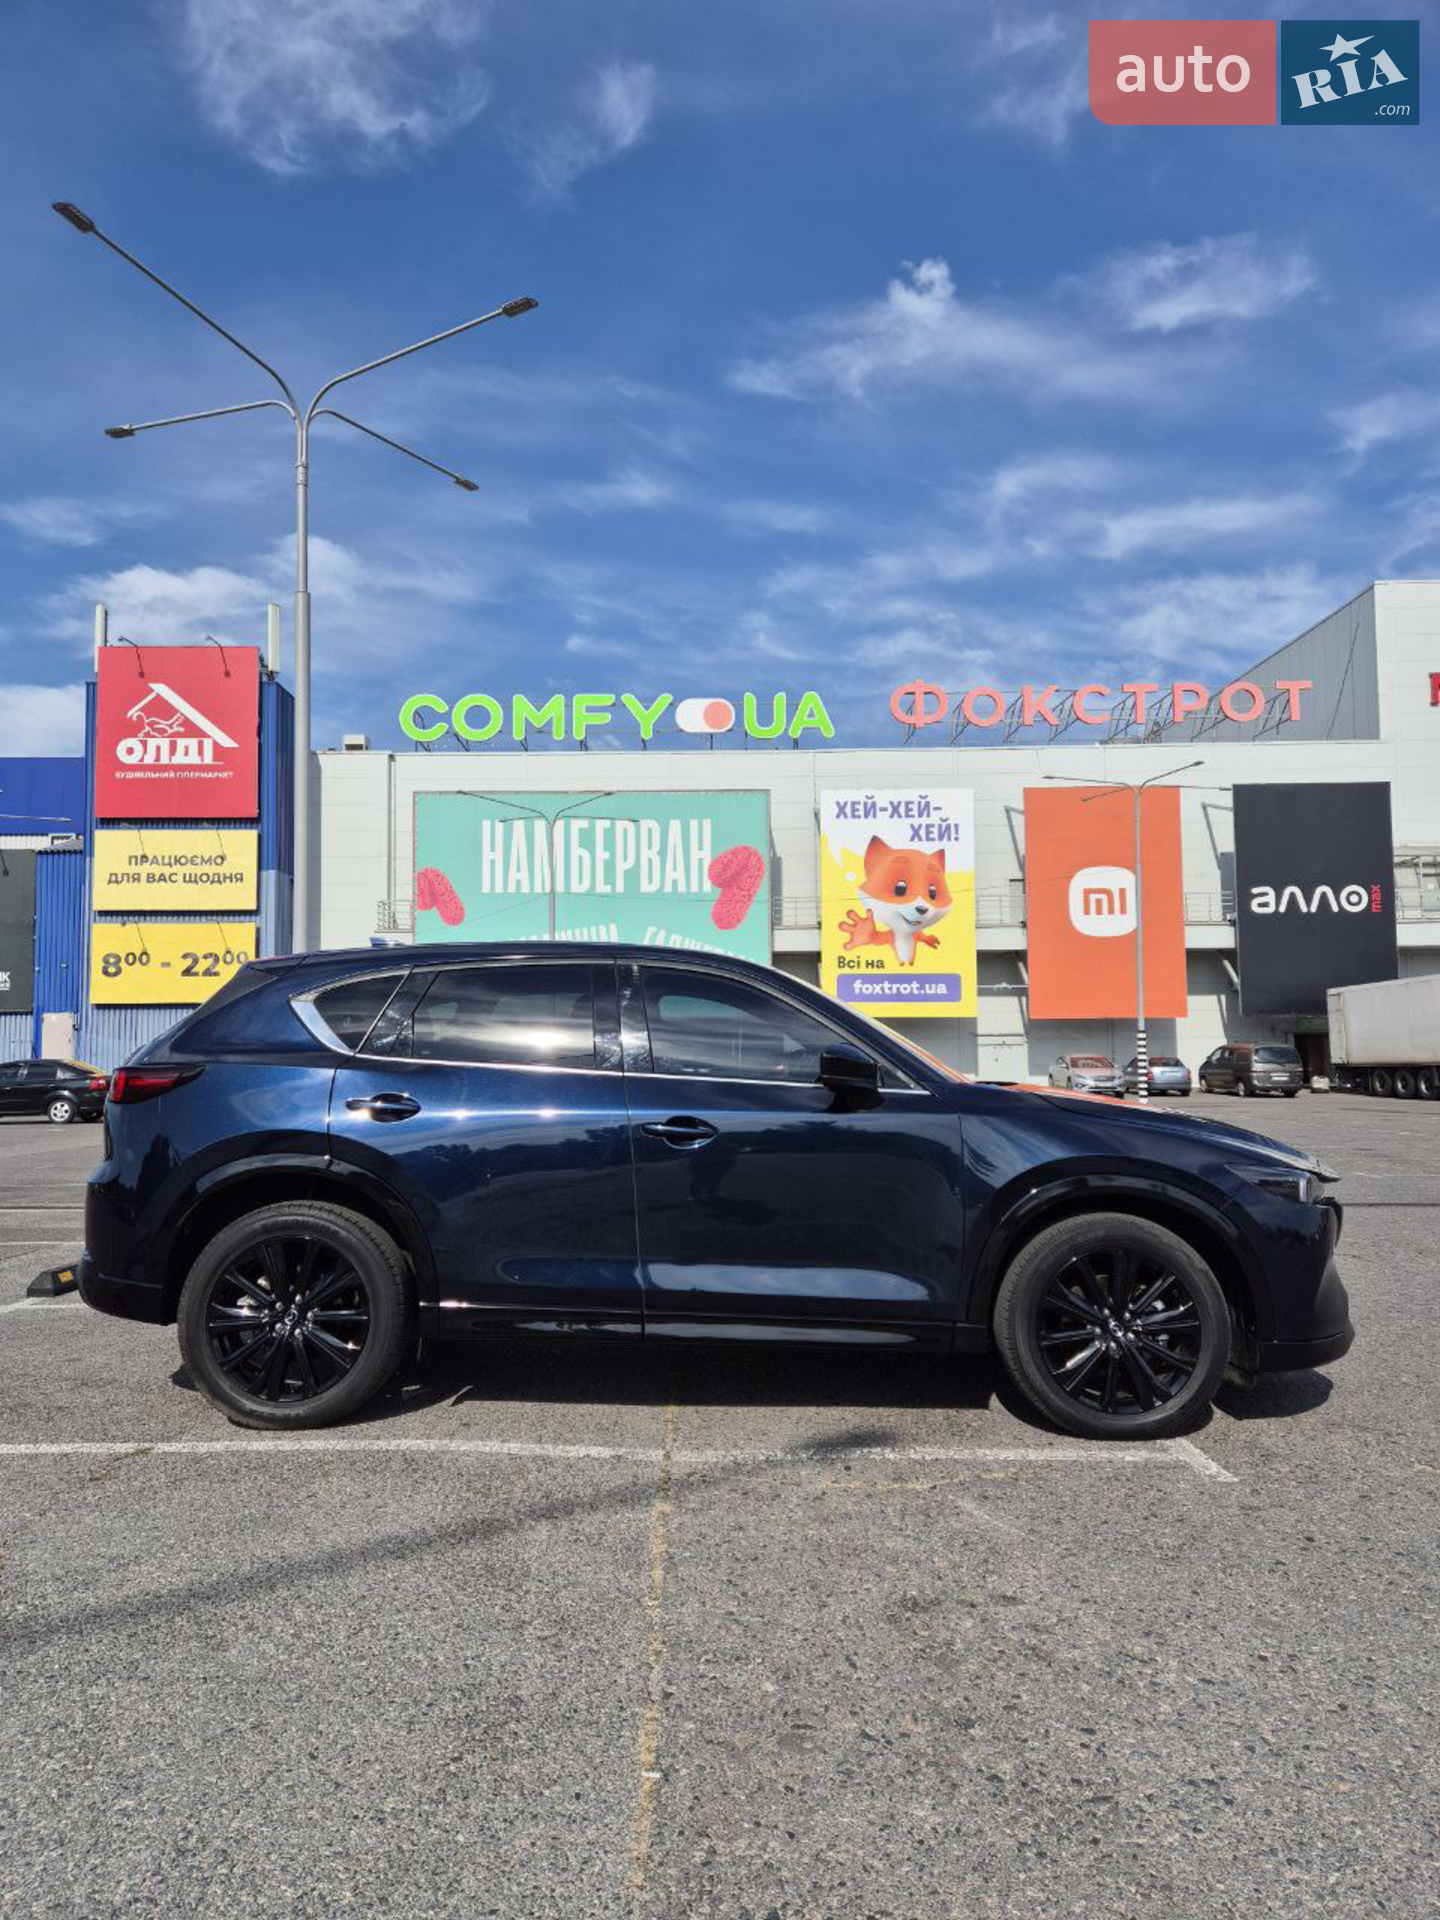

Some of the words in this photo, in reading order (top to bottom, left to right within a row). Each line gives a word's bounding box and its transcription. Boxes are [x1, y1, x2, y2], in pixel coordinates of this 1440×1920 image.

[890, 678, 1313, 729] ФОКСТРОТ
[399, 693, 674, 741] COMFY
[116, 738, 214, 765] ОЛДІ
[909, 817, 960, 842] ХЕЙ!
[128, 854, 226, 868] ПРАЦЮЄМО
[481, 818, 712, 894] НАМБЕРВАН
[107, 872, 142, 885] ДЛЯ
[146, 872, 179, 884] ВАС
[183, 872, 244, 885] ЩОДНЯ
[1371, 884, 1382, 913] max
[837, 955, 861, 969] Всі
[865, 959, 885, 969] на
[853, 979, 948, 995] foxtrot.ua
